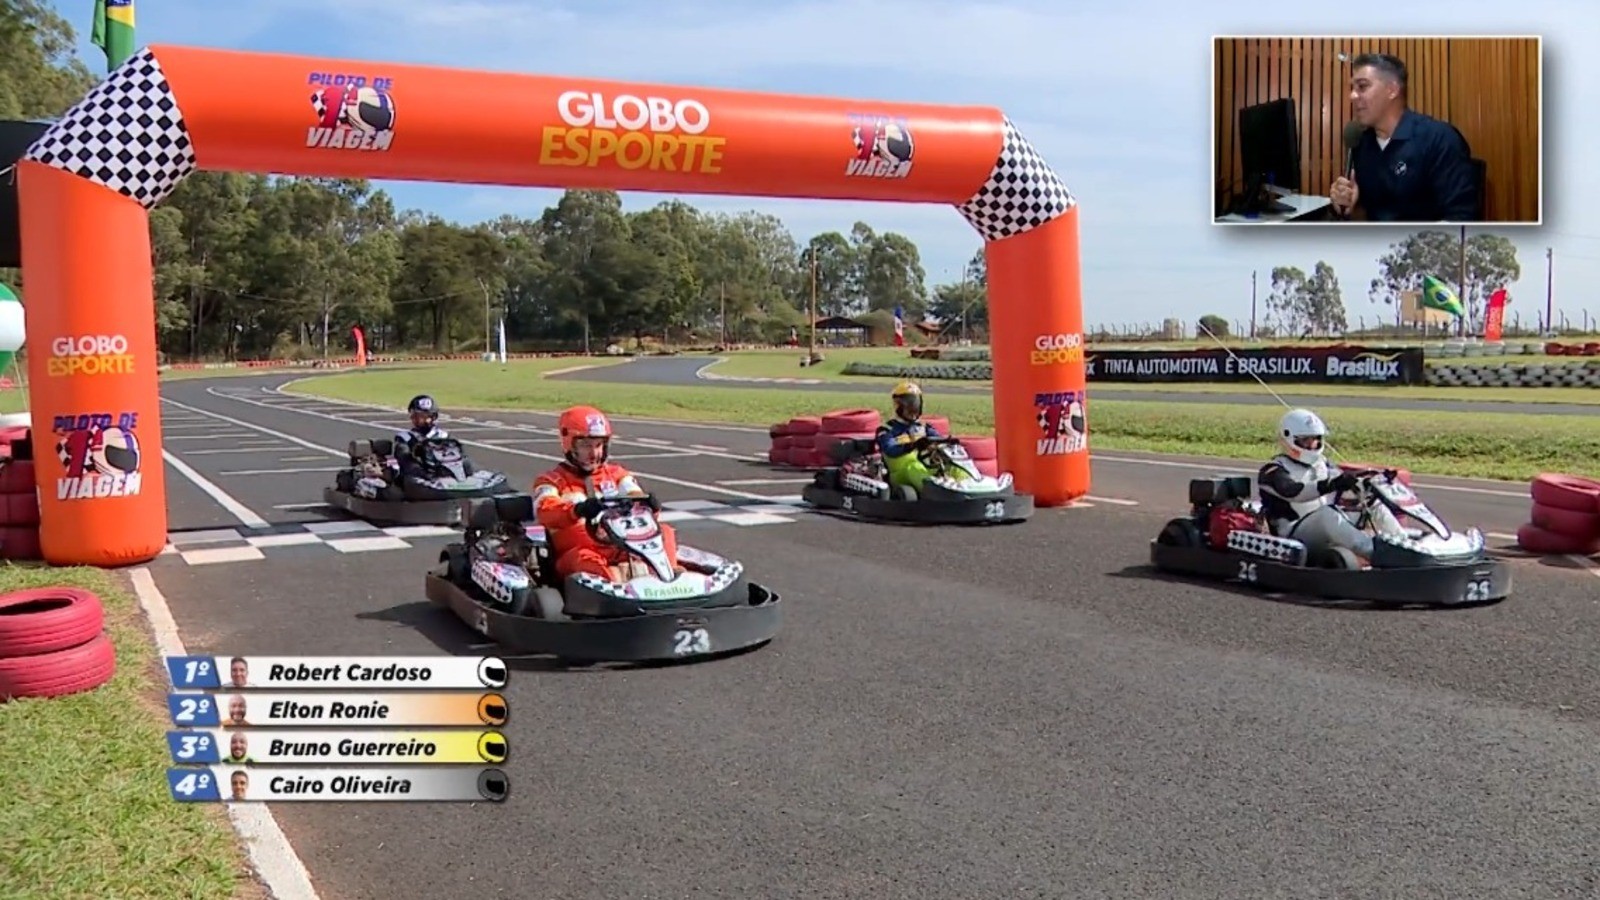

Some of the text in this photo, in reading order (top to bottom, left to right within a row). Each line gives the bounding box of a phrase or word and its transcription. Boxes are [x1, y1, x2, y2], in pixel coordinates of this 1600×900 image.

[308, 72, 393, 89] PILOTO DE
[557, 90, 710, 134] GLOBO
[306, 127, 395, 150] VIAGEM
[538, 125, 726, 174] ESPORTE
[52, 335, 128, 356] GLOBO
[1035, 333, 1081, 350] GLOBO
[47, 354, 135, 376] ESPORTE
[1104, 359, 1134, 374] TINTA
[1136, 358, 1218, 374] AUTOMOTIVA
[1238, 357, 1316, 374] BRASILUX.
[1326, 356, 1399, 376] Brasilux
[53, 412, 138, 432] PILOTO DE
[57, 474, 142, 500] VIAGEM
[673, 627, 711, 654] 23
